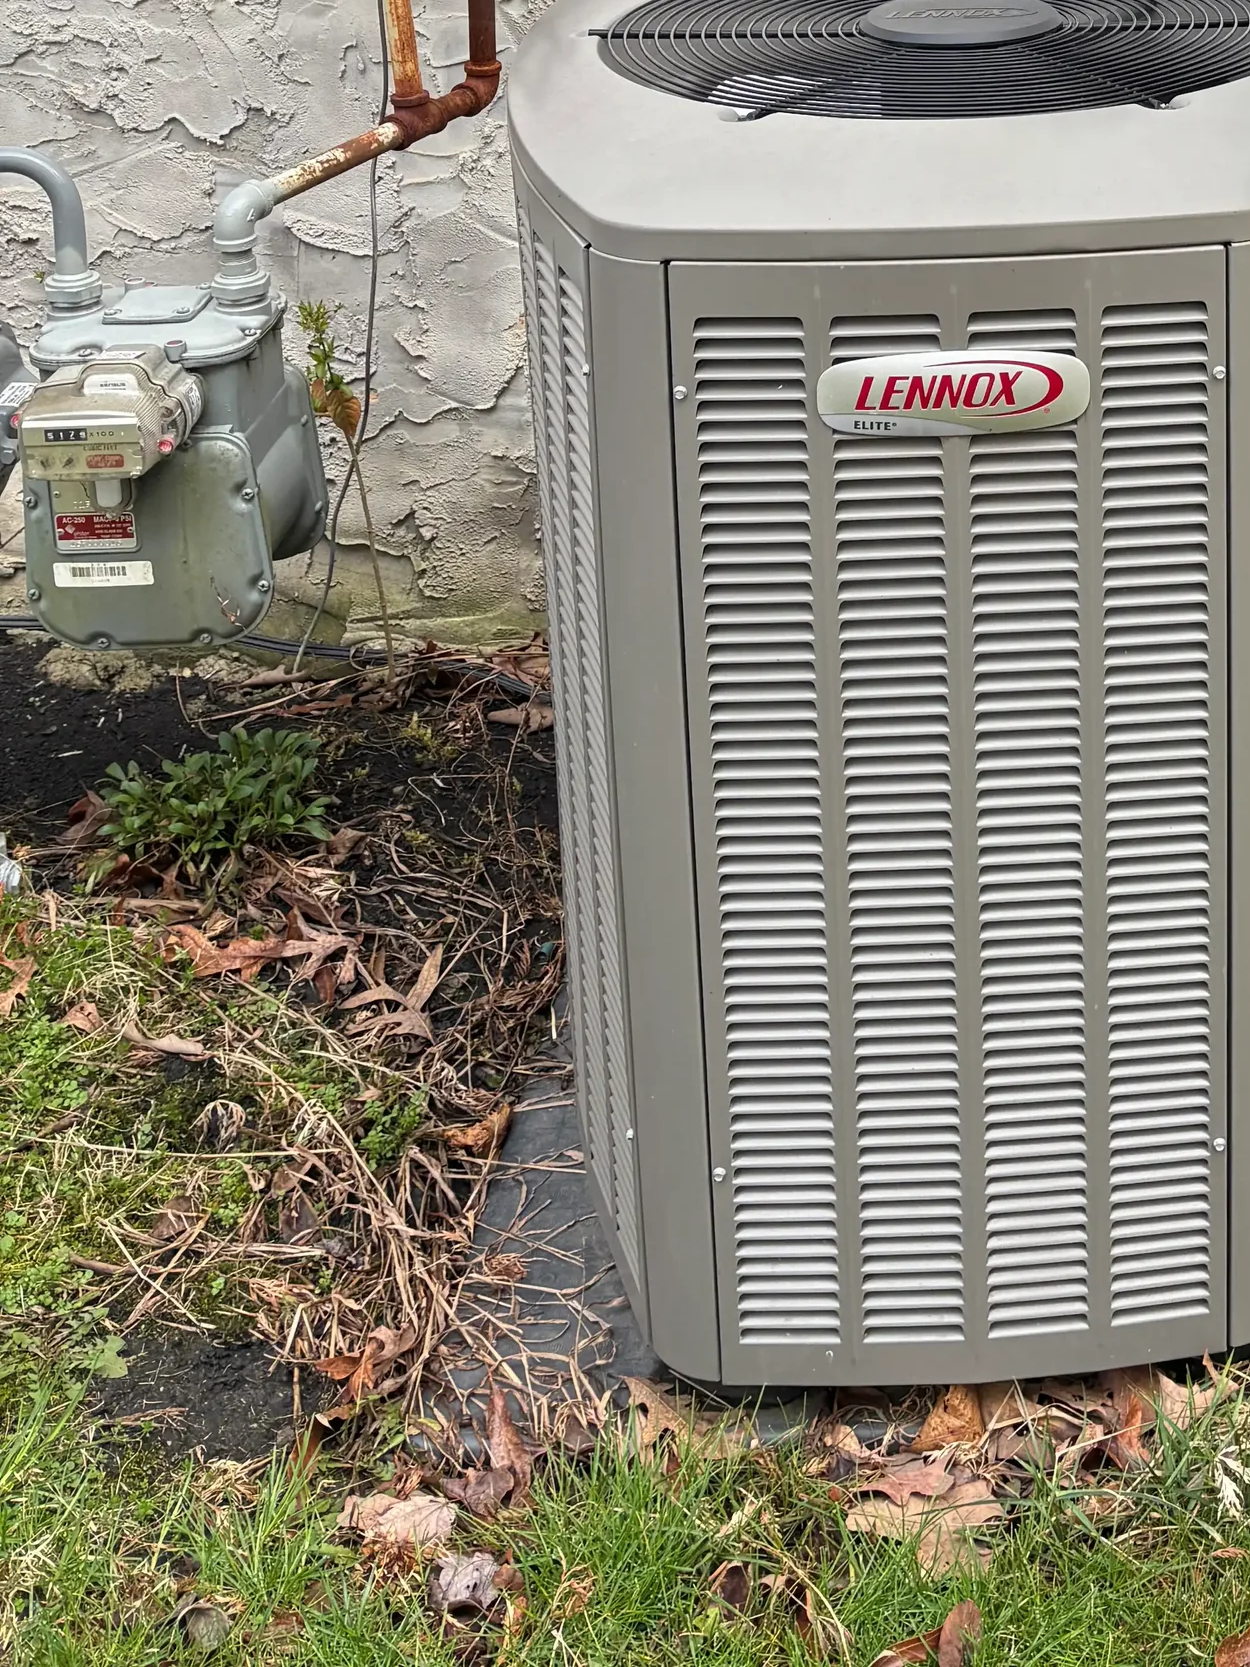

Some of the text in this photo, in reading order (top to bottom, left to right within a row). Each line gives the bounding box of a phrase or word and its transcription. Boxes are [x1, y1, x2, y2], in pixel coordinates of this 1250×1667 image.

[885, 8, 1005, 19] LENNOX
[854, 370, 1023, 411] LENNOX
[62, 516, 86, 524] AC-250
